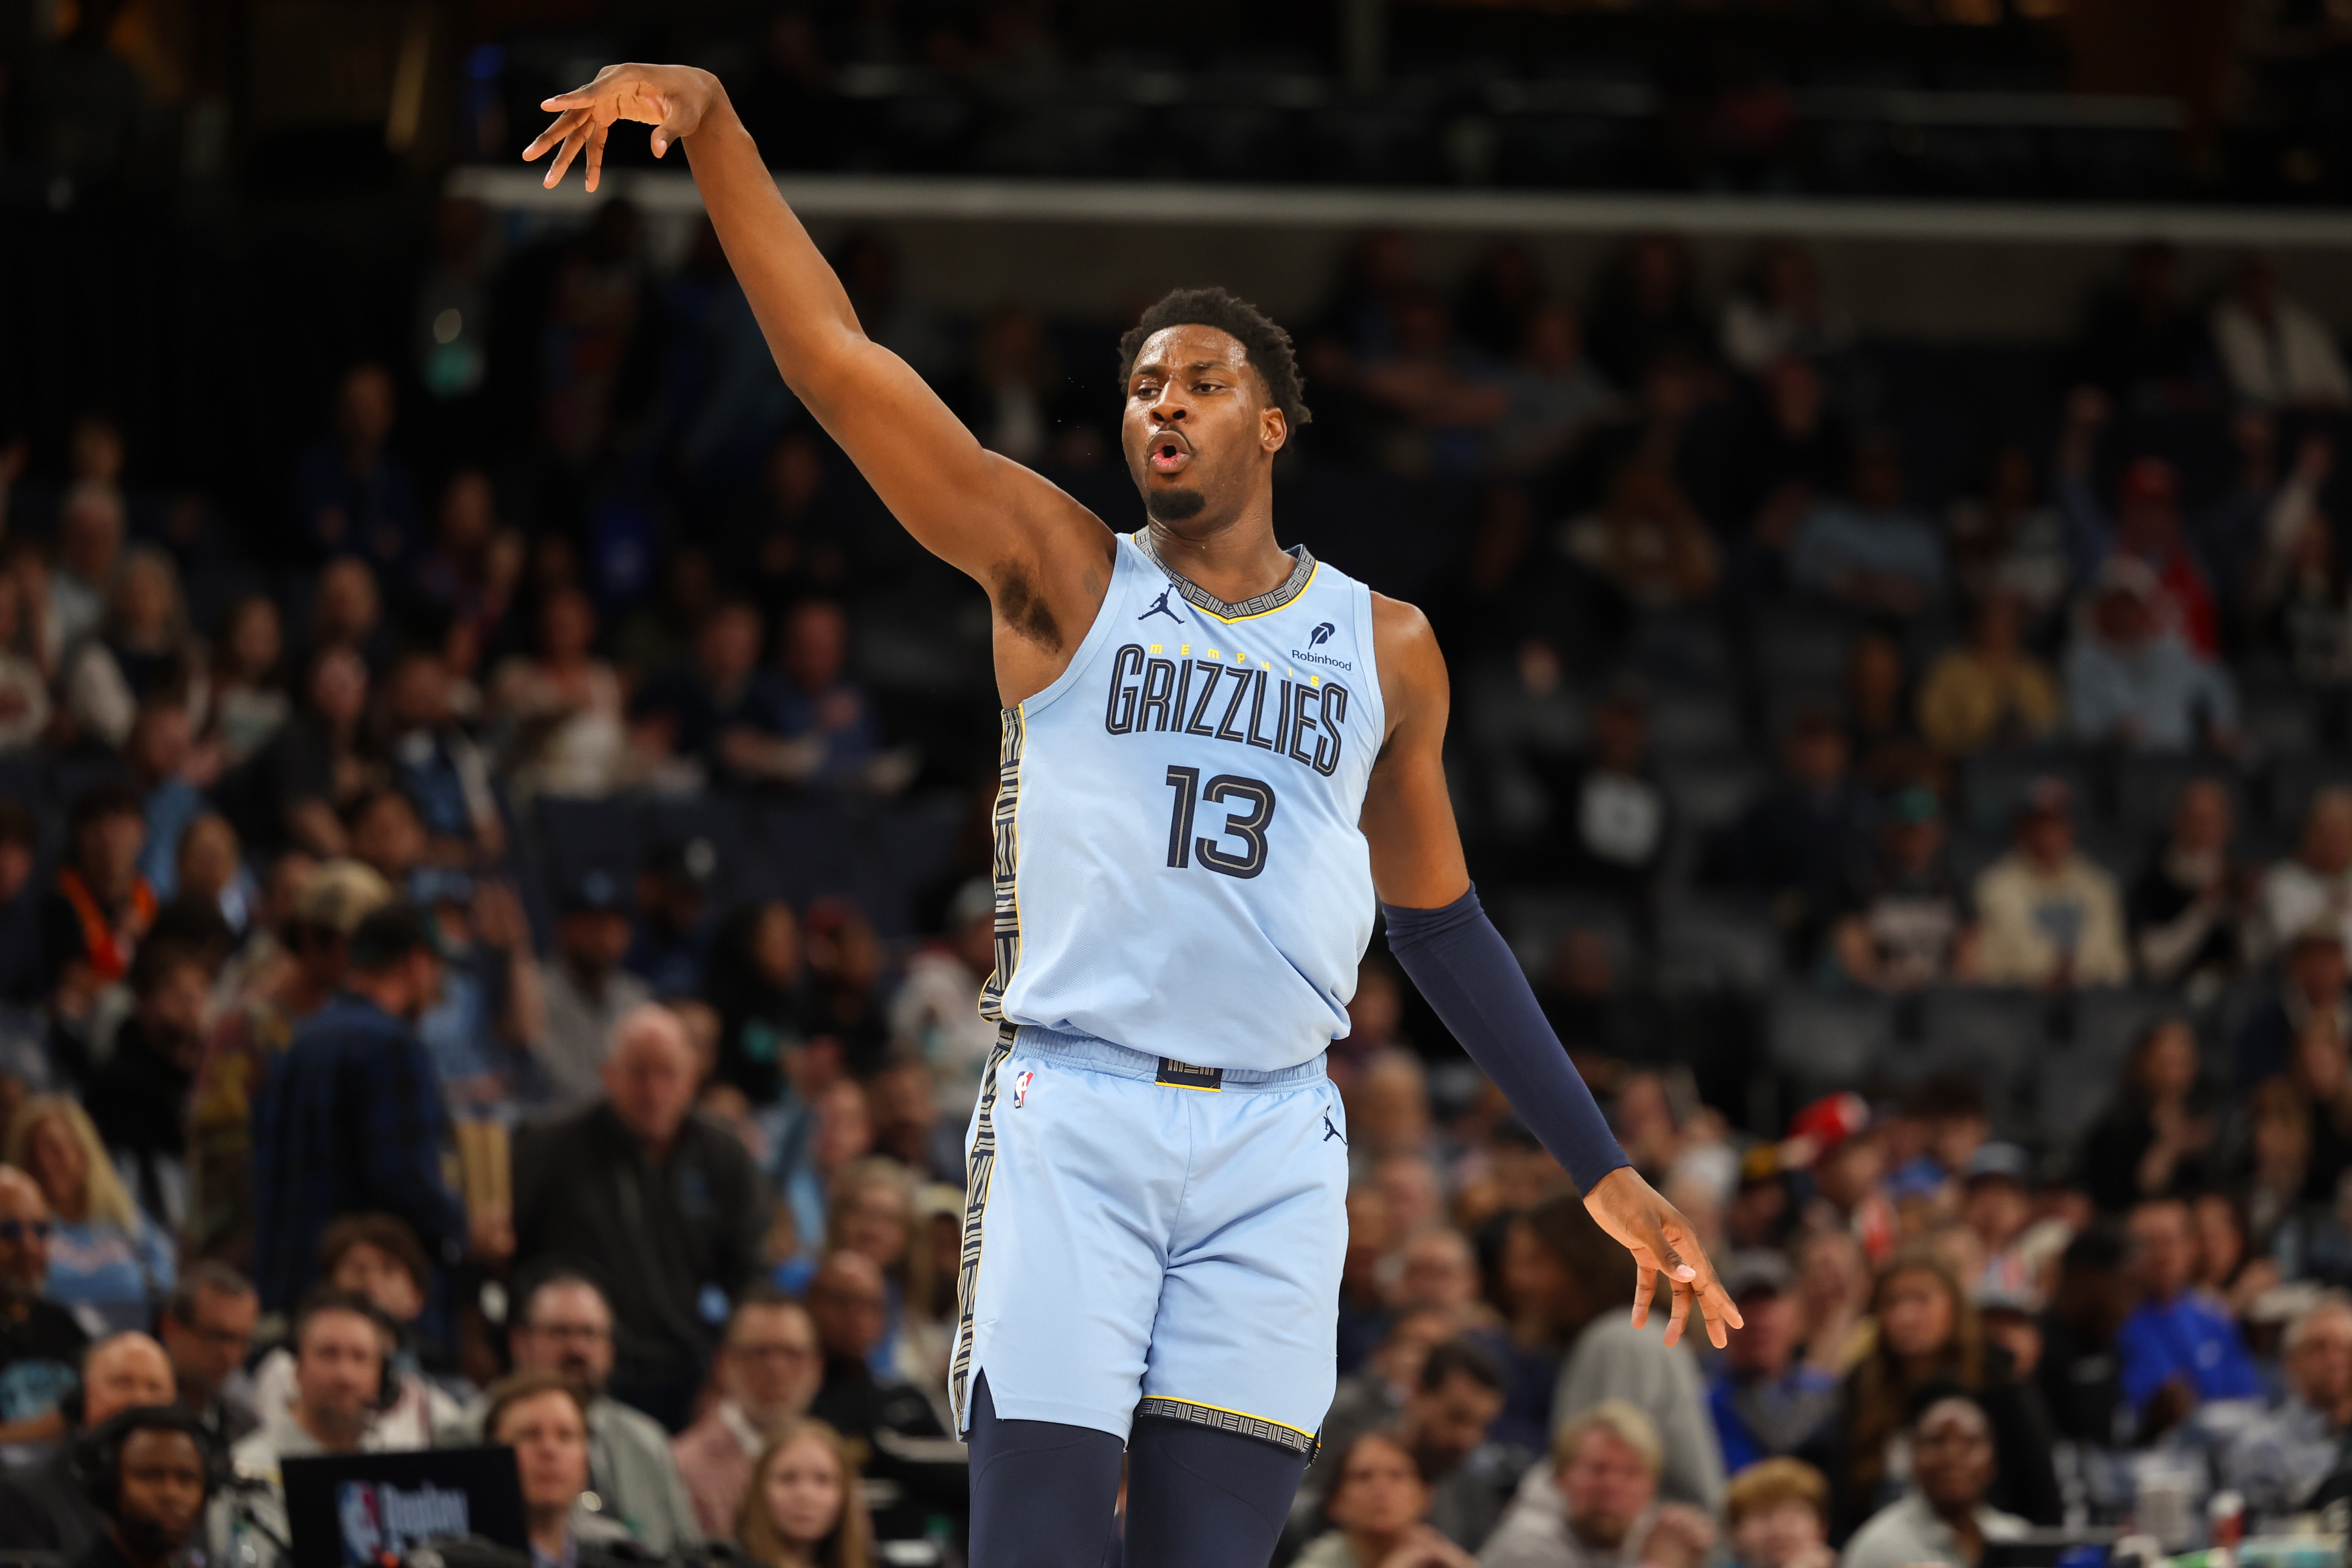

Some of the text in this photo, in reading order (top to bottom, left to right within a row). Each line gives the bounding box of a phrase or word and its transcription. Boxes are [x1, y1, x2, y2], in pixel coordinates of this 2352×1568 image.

[1105, 644, 1348, 777] GRIZZLIES
[1292, 649, 1351, 671] Robinhood
[1166, 764, 1276, 879] 13
